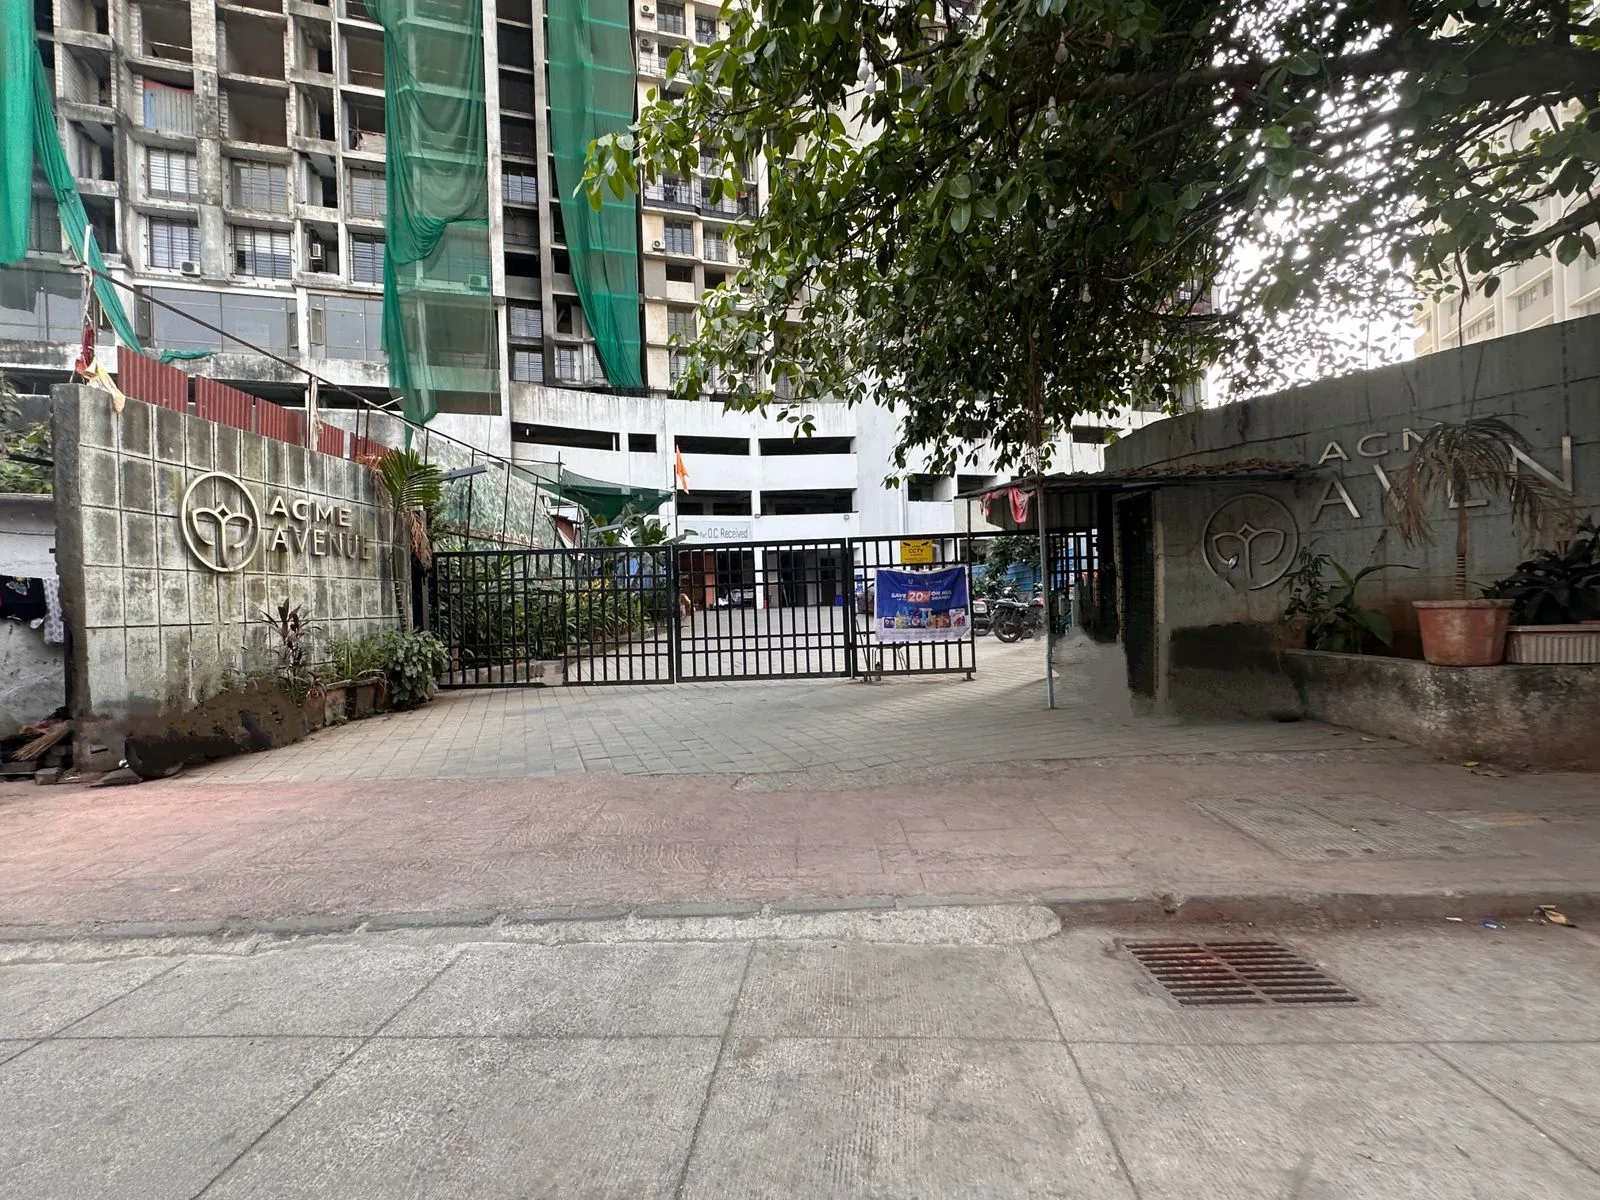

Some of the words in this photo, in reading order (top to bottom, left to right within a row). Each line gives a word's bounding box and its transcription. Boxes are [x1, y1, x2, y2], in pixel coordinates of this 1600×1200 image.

[1317, 423, 1444, 465] ACM
[268, 495, 352, 527] ACME
[268, 525, 371, 560] AVENUE
[720, 528, 748, 539] Received
